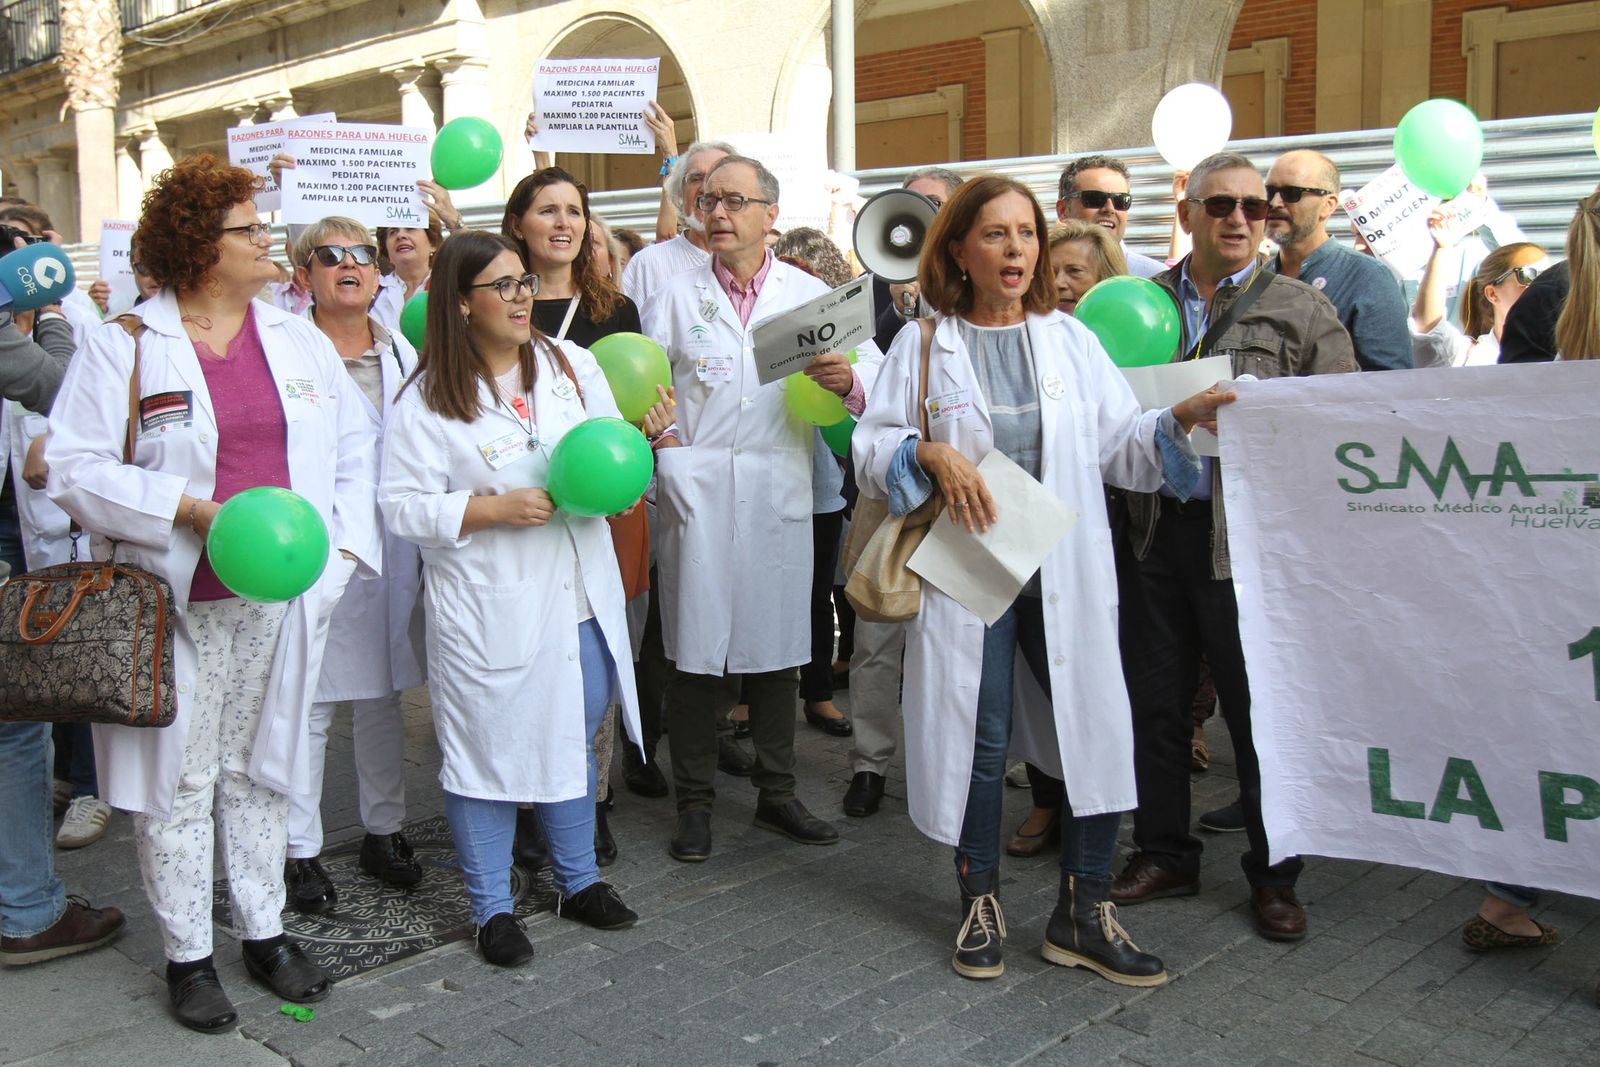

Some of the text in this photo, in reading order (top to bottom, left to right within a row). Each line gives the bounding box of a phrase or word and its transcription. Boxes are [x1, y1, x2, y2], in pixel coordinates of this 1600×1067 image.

[540, 64, 657, 73] RAZONES PARA UNA HUELGA
[232, 128, 284, 142] RAZONES PARA
[288, 130, 428, 142] RAZONES PARA UNA HUELGA
[618, 134, 645, 146] SMA
[249, 143, 282, 153] MEDICINA
[310, 147, 403, 156] MEDICINA FAMILIAR
[240, 156, 269, 164] MAXIMO
[366, 184, 414, 192] PACIENTES
[302, 194, 344, 202] AMPLIAR
[360, 196, 410, 204] PLANTILLA
[1369, 184, 1410, 220] MINUT
[386, 207, 417, 220] SMA
[1366, 229, 1386, 242] OR
[1387, 194, 1429, 232] PACIEN
[18, 266, 38, 296] COPE
[796, 322, 836, 347] NO
[770, 350, 816, 370] Contratos
[820, 347, 830, 355] de
[1335, 435, 1540, 502] SMA
[1346, 501, 1590, 516] Sindicato Médico Andaluz
[1510, 514, 1600, 530] Huelva
[1367, 747, 1504, 832] LA
